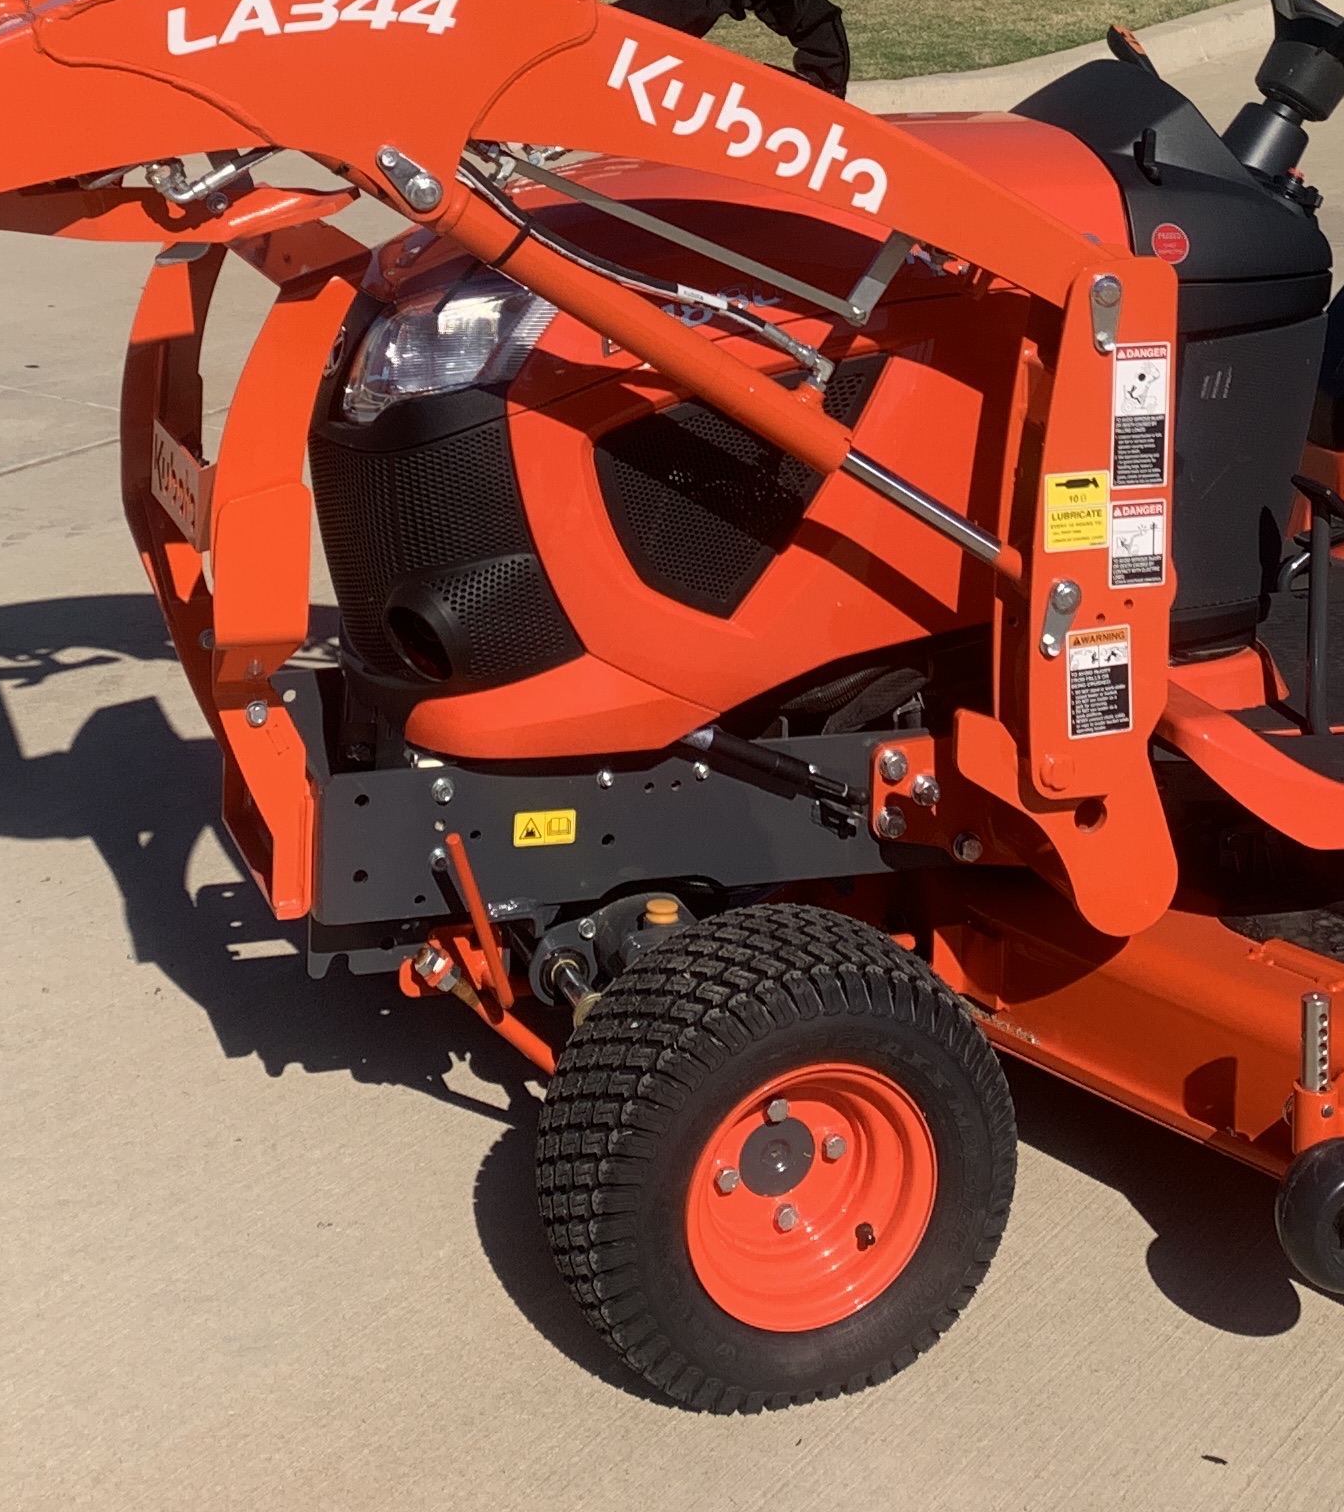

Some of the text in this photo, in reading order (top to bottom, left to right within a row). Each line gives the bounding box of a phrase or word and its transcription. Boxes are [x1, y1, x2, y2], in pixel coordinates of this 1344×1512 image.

[606, 37, 889, 215] Kubota
[1126, 347, 1167, 359] DANGER
[1051, 509, 1103, 521] LUBRICATE
[1122, 504, 1163, 517] DANGER
[1081, 630, 1126, 644] WARNING
